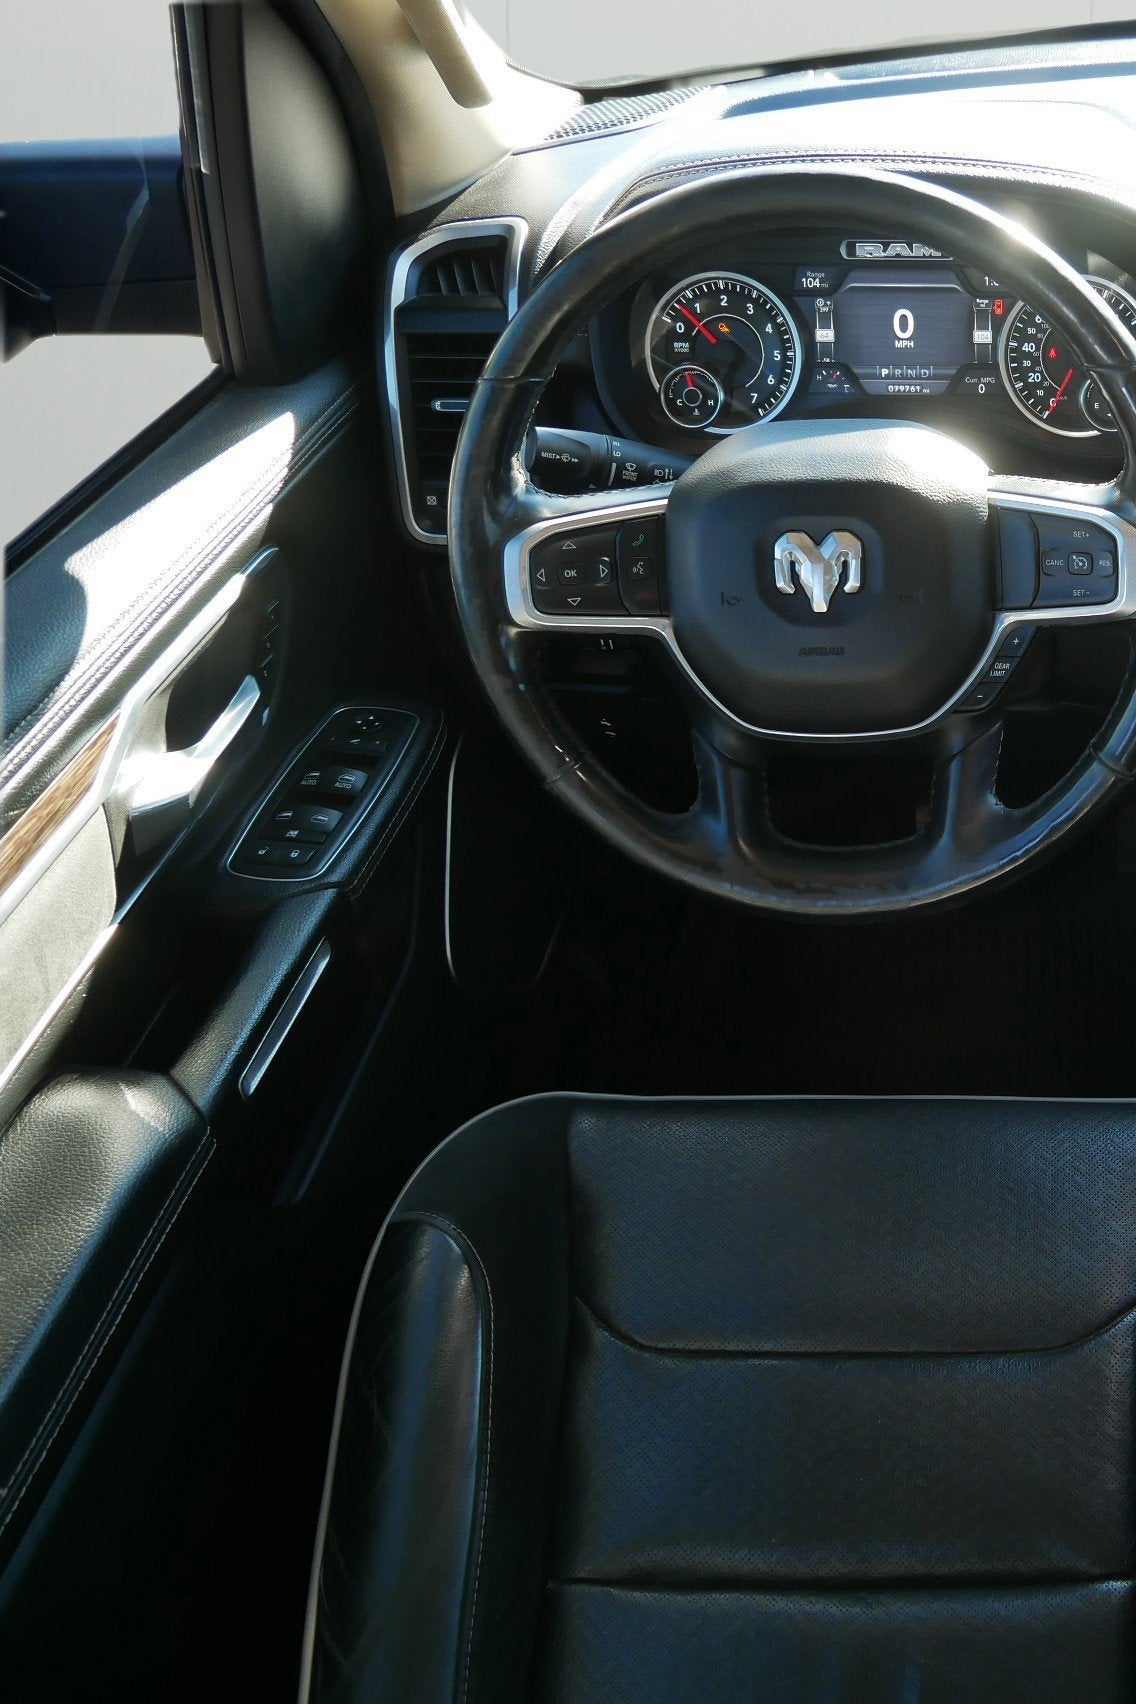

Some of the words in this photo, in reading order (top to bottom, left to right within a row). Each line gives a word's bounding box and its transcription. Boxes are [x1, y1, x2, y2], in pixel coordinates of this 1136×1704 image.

[856, 243, 941, 257] RAM
[802, 278, 820, 288] 104
[720, 296, 728, 305] 2
[695, 303, 700, 313] 1
[747, 304, 753, 314] 3
[676, 322, 684, 333] 0
[766, 324, 772, 333] 4
[893, 309, 914, 339] 0
[1022, 343, 1035, 352] 40
[774, 351, 781, 360] 5
[881, 369, 888, 377] P
[1028, 373, 1041, 382] 20
[768, 375, 774, 384] 6
[979, 385, 985, 393] 0
[751, 394, 757, 403] 7
[541, 451, 556, 459] MIST
